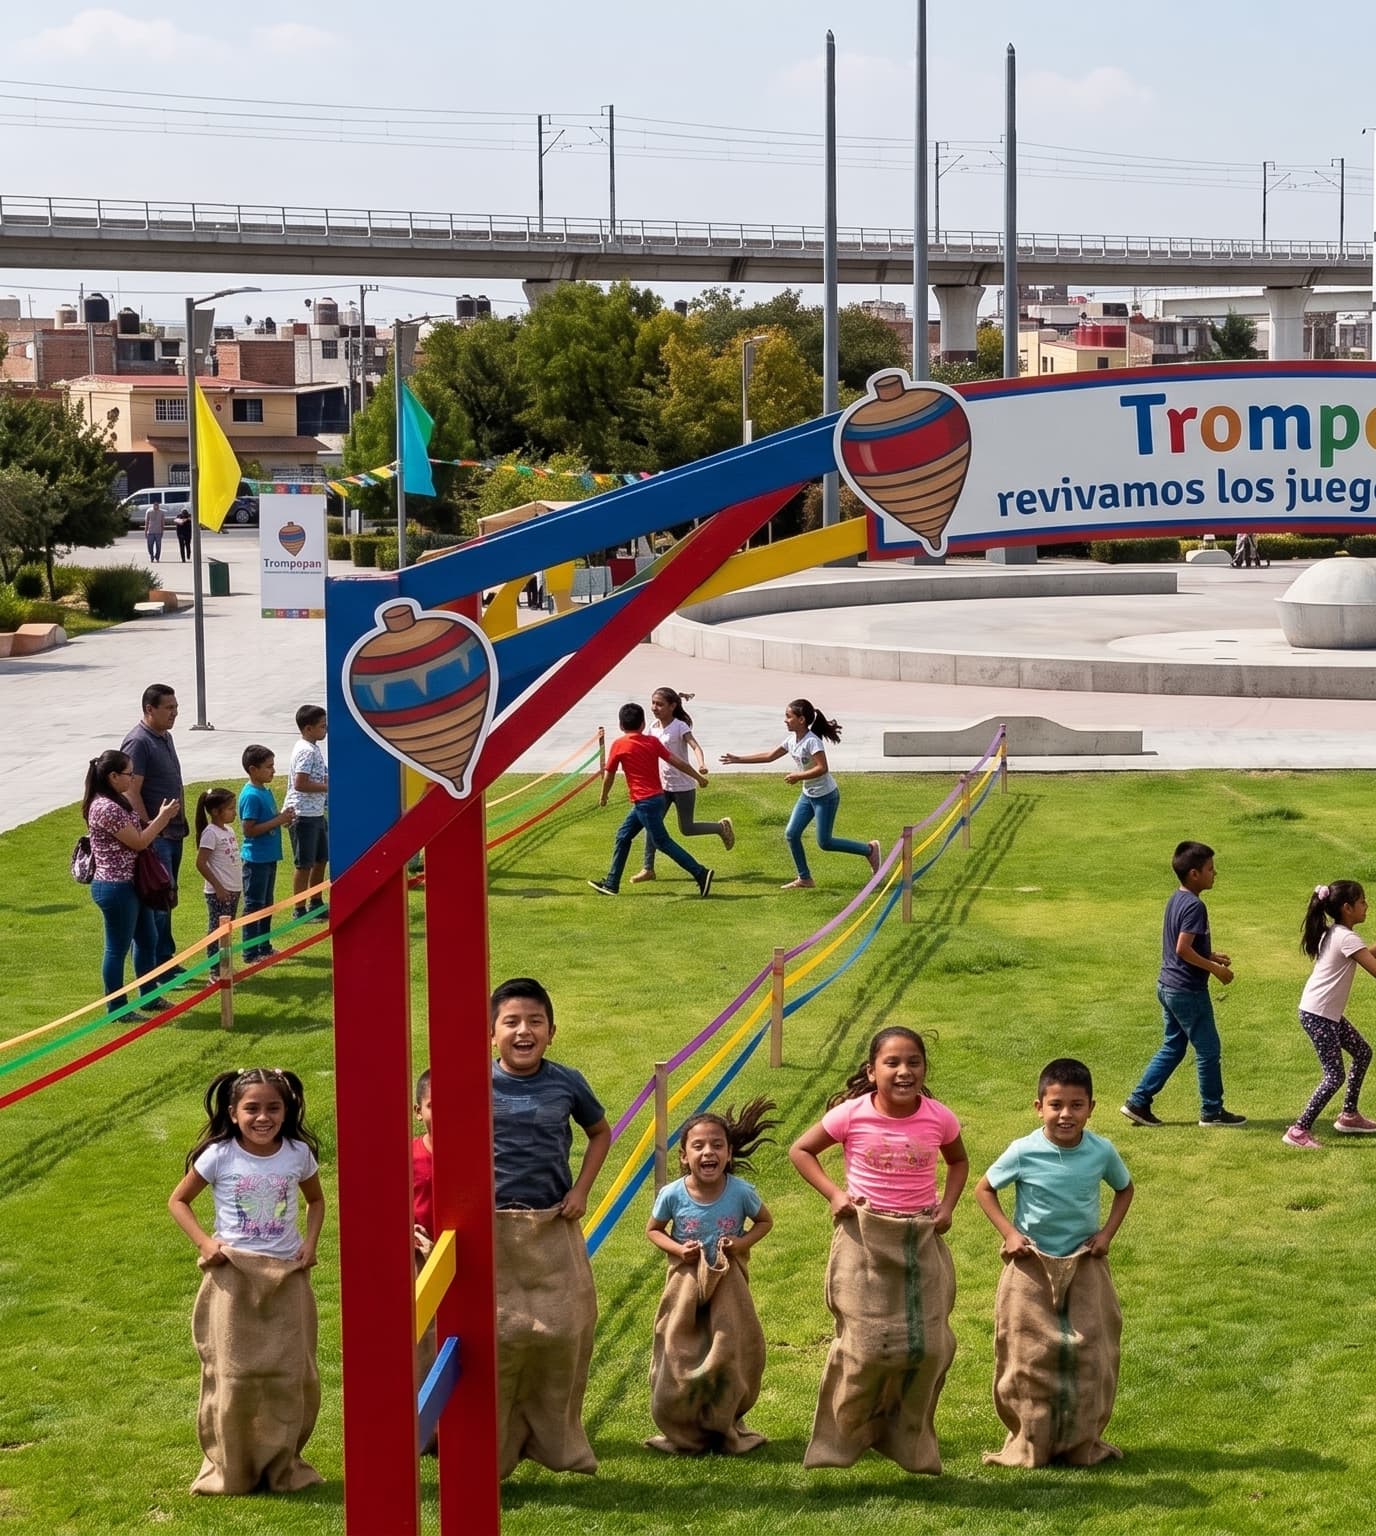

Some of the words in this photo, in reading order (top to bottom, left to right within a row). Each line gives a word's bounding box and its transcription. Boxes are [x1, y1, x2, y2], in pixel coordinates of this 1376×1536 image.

[996, 476, 1206, 517] revivamos
[1217, 467, 1275, 504] los
[263, 558, 322, 570] Trompopan
